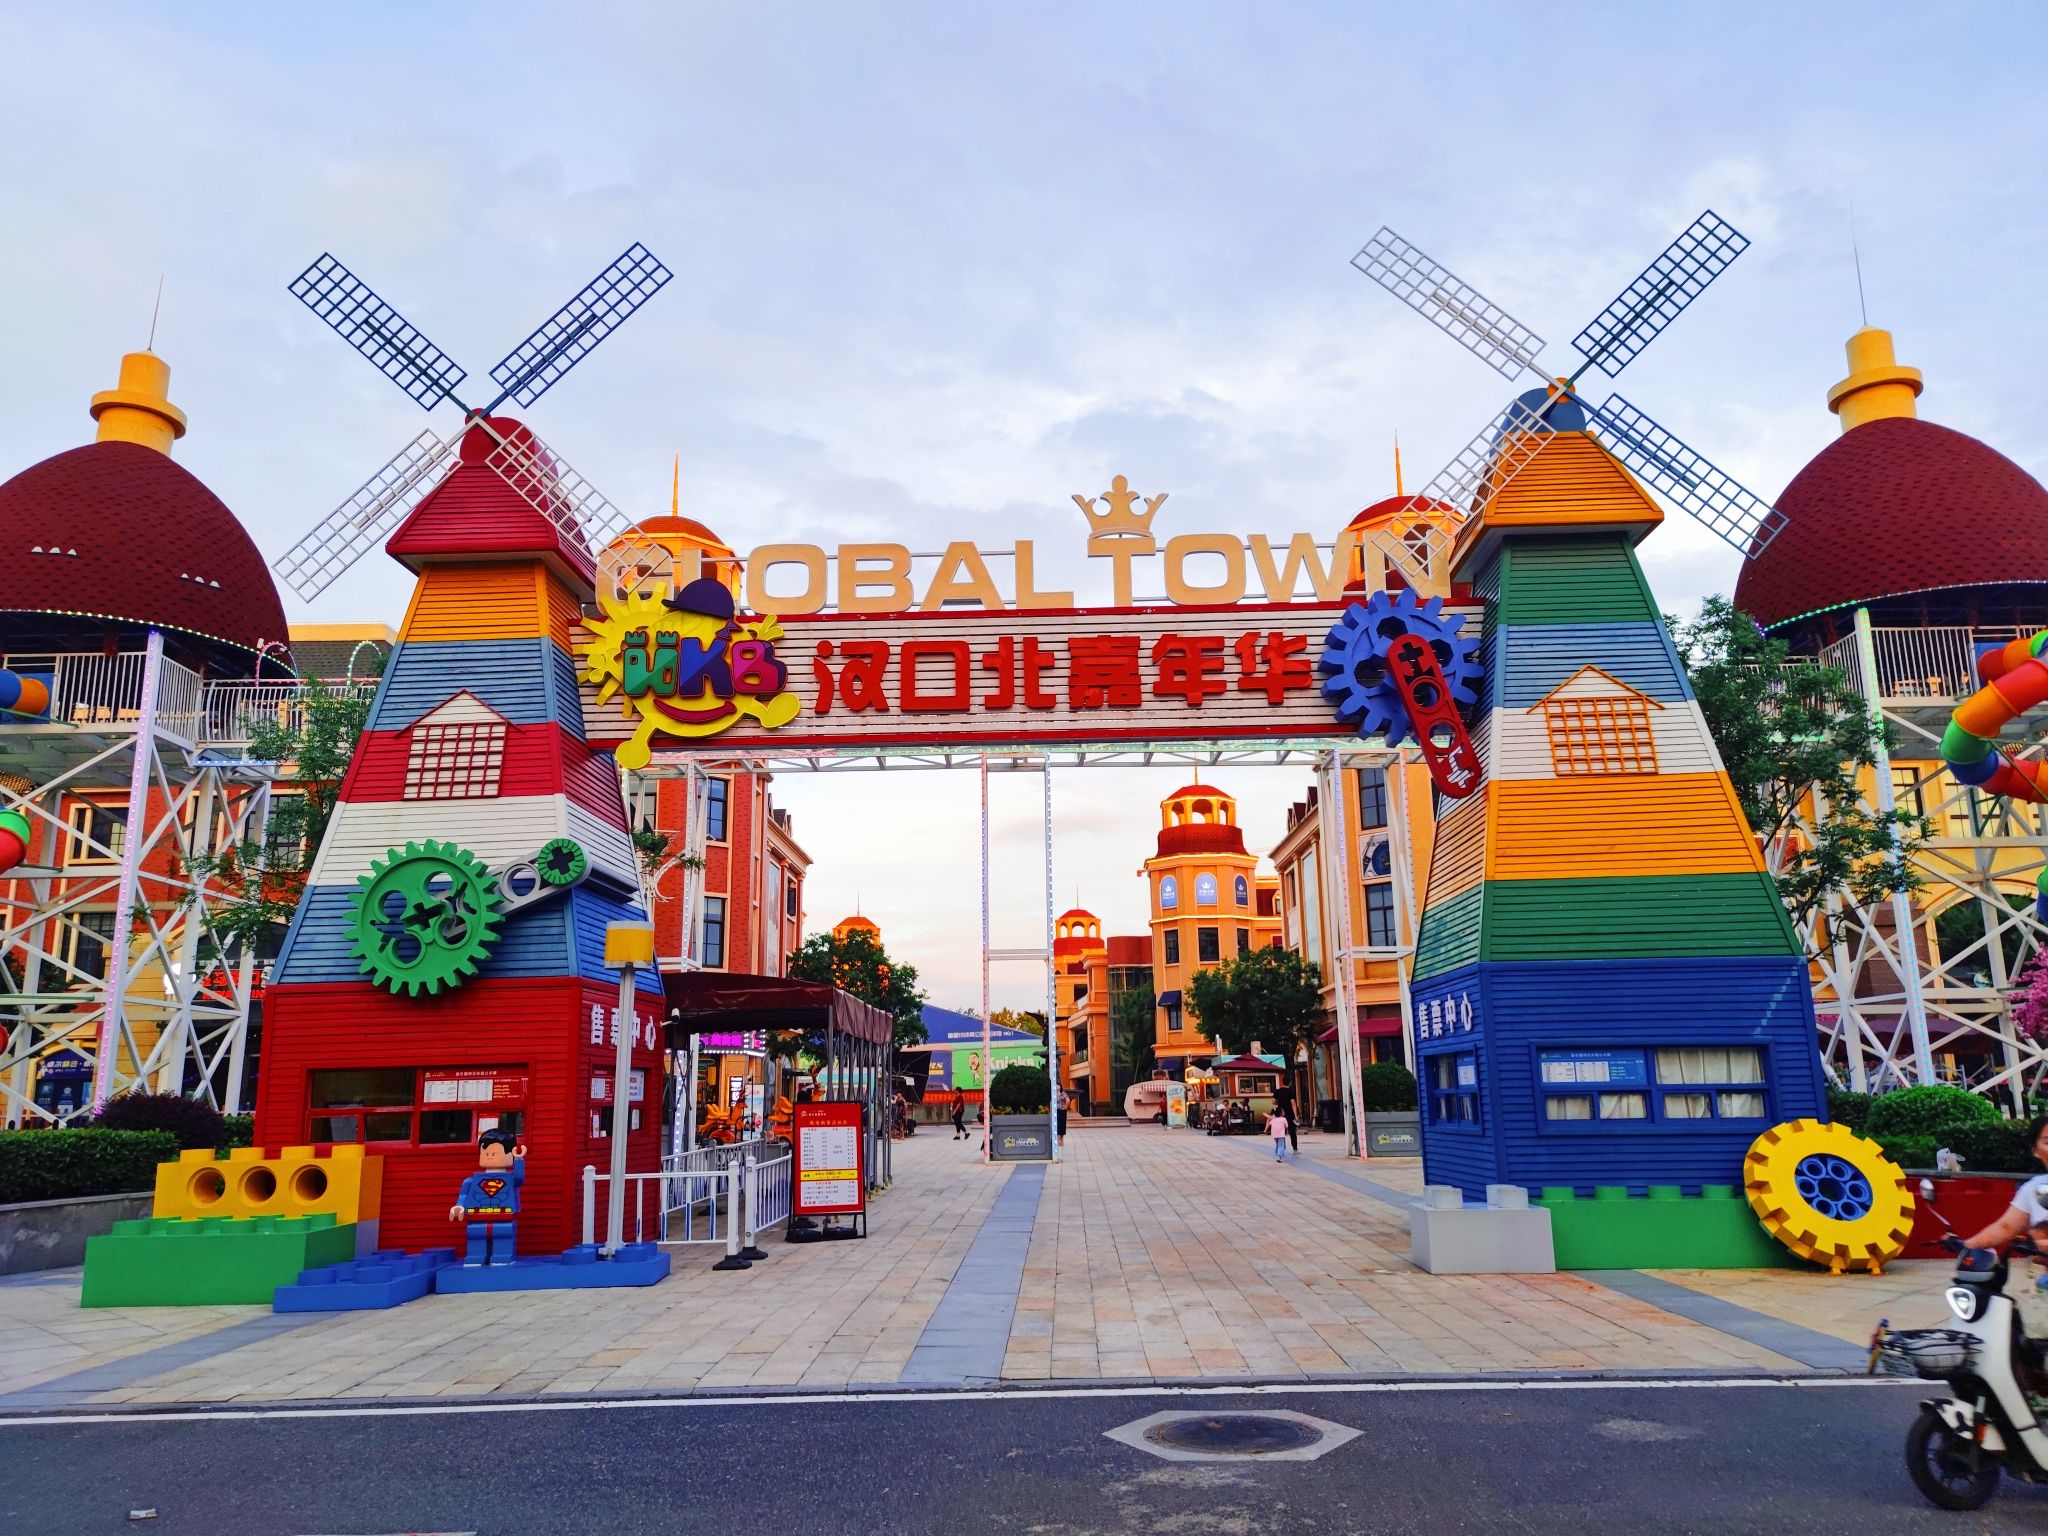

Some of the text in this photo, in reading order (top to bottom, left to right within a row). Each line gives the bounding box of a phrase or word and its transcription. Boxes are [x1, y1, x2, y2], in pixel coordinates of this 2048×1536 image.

[1087, 531, 1452, 607] TOWN
[813, 632, 1312, 714] 汉口北嘉年华
[1418, 991, 1473, 1040] 售票中心
